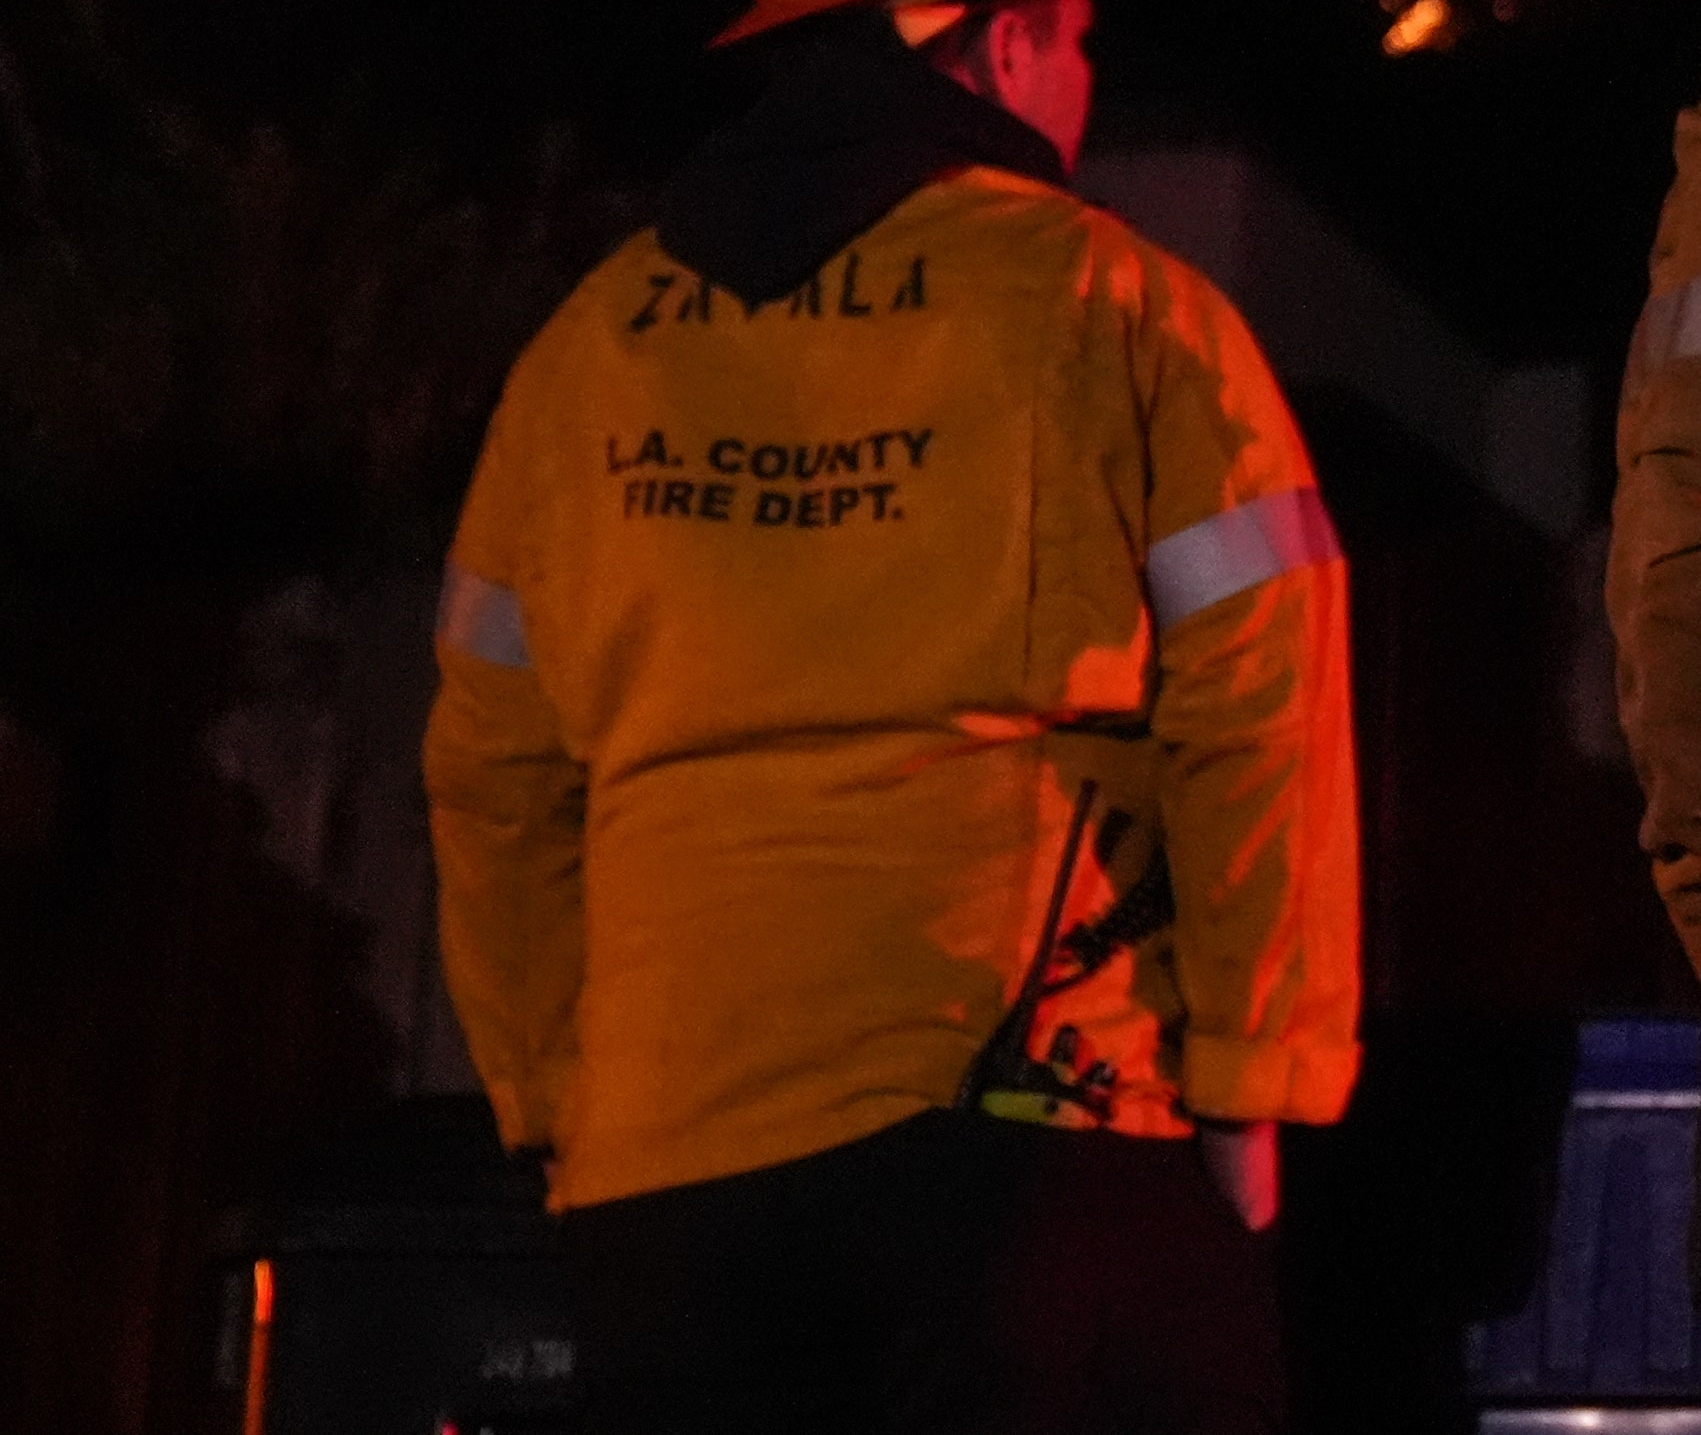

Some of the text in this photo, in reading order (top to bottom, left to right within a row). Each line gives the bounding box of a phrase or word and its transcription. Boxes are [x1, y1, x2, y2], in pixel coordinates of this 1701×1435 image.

[627, 251, 928, 334] ZAALA
[708, 428, 934, 481] COUNTY
[624, 480, 905, 529] FIRE DEPT.
